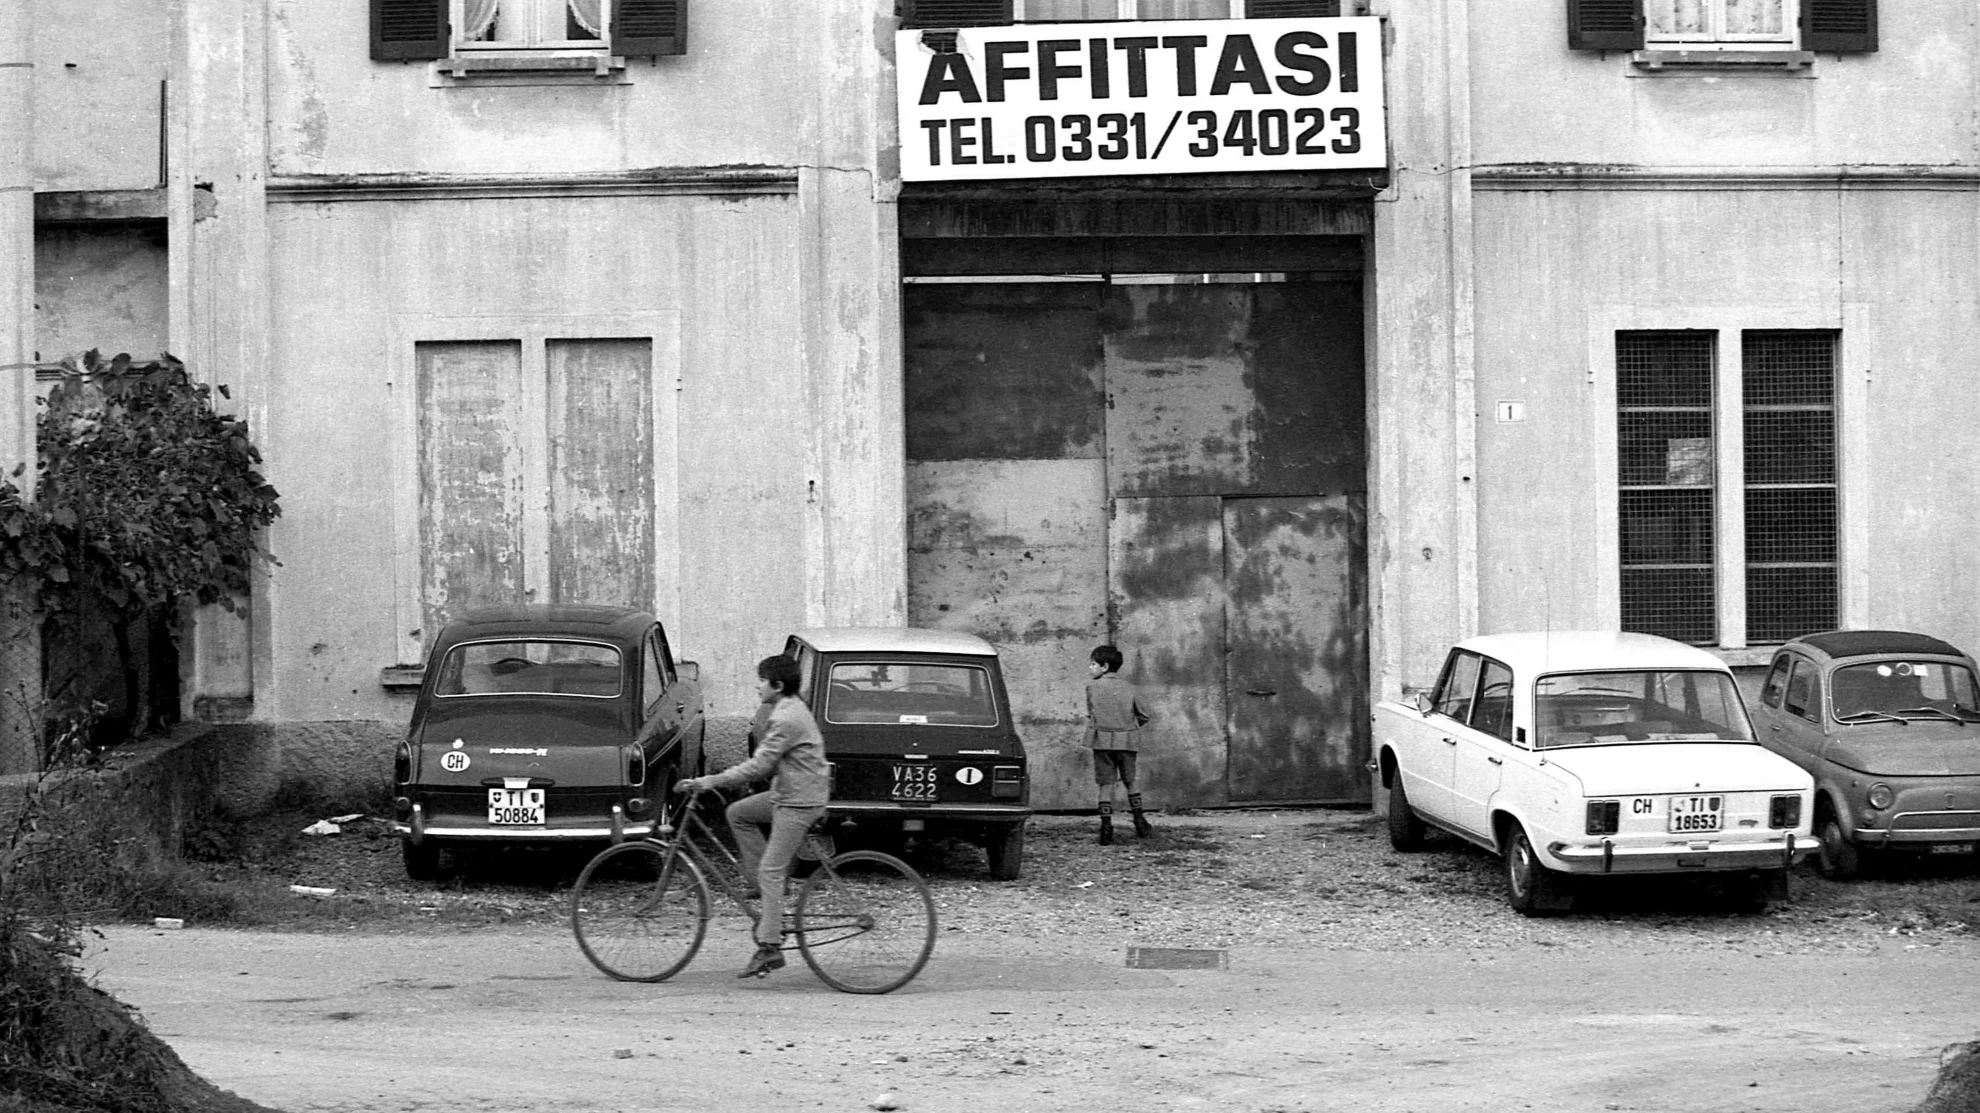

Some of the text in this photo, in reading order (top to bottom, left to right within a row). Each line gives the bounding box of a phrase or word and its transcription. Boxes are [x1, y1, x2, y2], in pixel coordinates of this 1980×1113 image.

[918, 31, 1358, 105] AFFITTASI
[1507, 404, 1513, 420] 1
[446, 754, 464, 770] CH
[893, 766, 937, 782] VA36
[966, 768, 973, 784] I
[506, 791, 524, 807] TI
[891, 784, 937, 799] 4622
[1633, 798, 1652, 813] CH
[1689, 797, 1704, 812] TI
[494, 807, 539, 824] 50884
[1675, 814, 1717, 830] 18653
